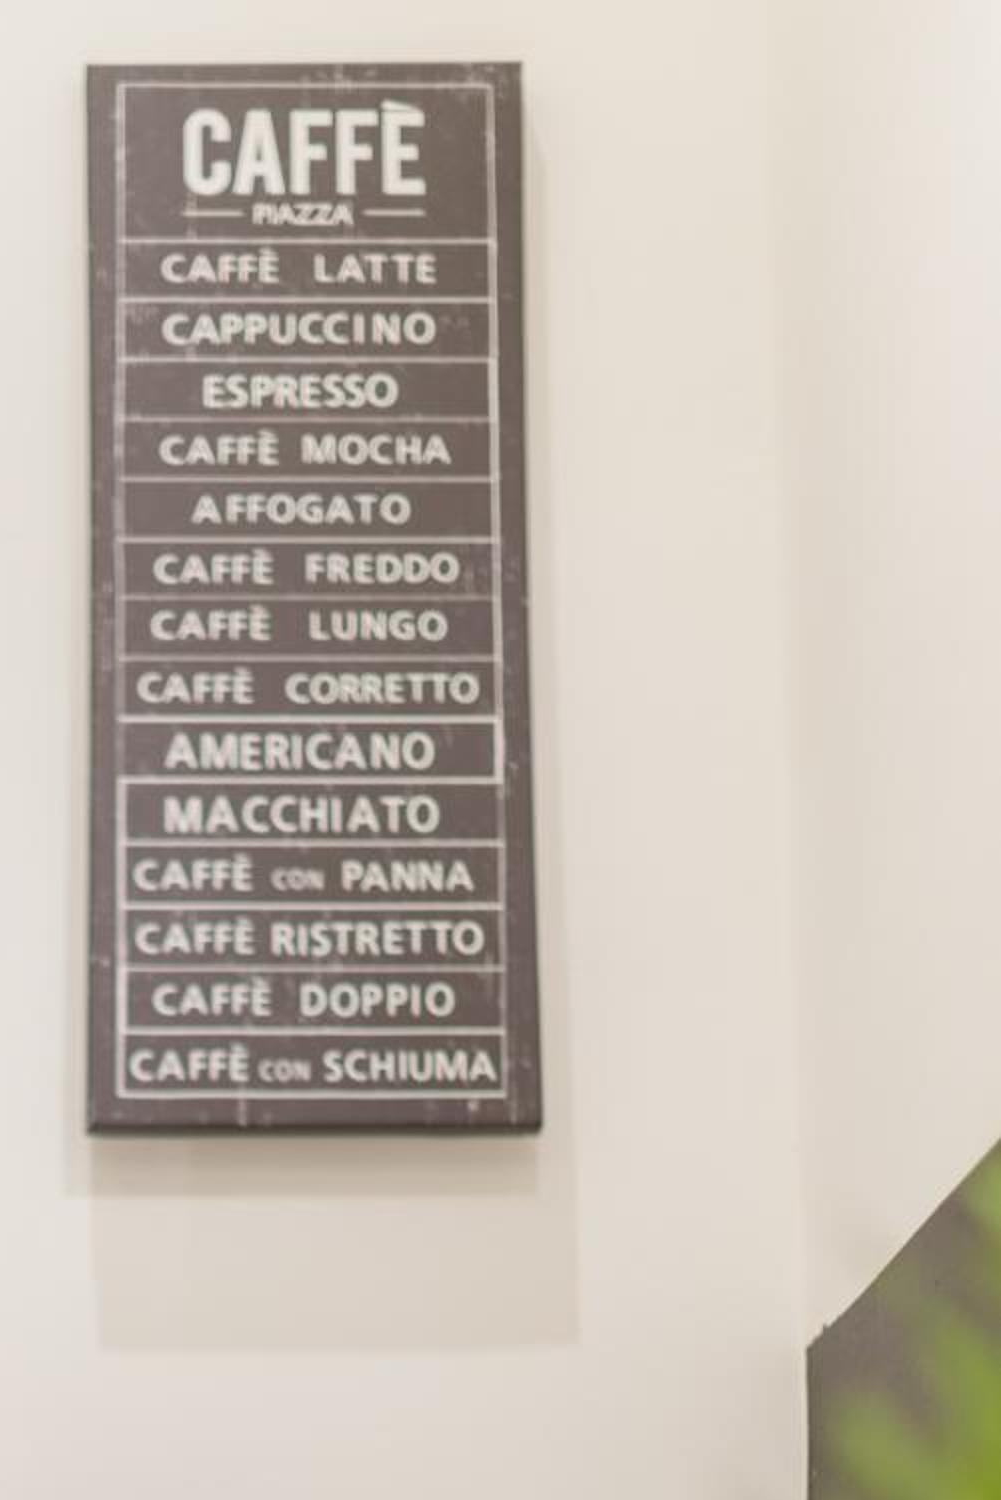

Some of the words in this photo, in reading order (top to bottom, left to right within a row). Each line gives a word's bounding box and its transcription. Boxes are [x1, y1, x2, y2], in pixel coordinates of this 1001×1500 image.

[182, 100, 427, 195] CAFFÈ
[251, 203, 354, 226] PIAZZA
[160, 248, 279, 284] CAFFÈ
[314, 254, 437, 284] LATTE
[161, 313, 437, 345] CAPPUCCINO
[202, 373, 399, 408] ESPRESSO
[158, 430, 279, 466] CAFFÈ
[301, 435, 452, 466] MOCHA
[191, 494, 411, 525] AFFOGATO
[152, 549, 274, 585] CAFFÈ
[304, 553, 460, 584] FREDDO
[150, 604, 271, 642] CAFFÈ
[308, 611, 448, 642] LUNGO
[136, 667, 255, 704] CAFFÈ
[285, 673, 480, 704] CORRETTO
[164, 732, 436, 771] AMERICANO
[163, 796, 440, 833] MACCHIATO
[132, 854, 253, 891] CAFFÈ
[271, 868, 324, 891] CON
[341, 860, 475, 892] PANNA
[134, 918, 255, 955] CAFFÈ
[270, 921, 485, 957] RISTRETTO
[151, 978, 272, 1018] CAFFÈ
[299, 982, 455, 1018] DOPPIO
[129, 1044, 249, 1083] CAFFÈ
[258, 1060, 311, 1081] CON
[323, 1050, 497, 1082] SCHIUMA
